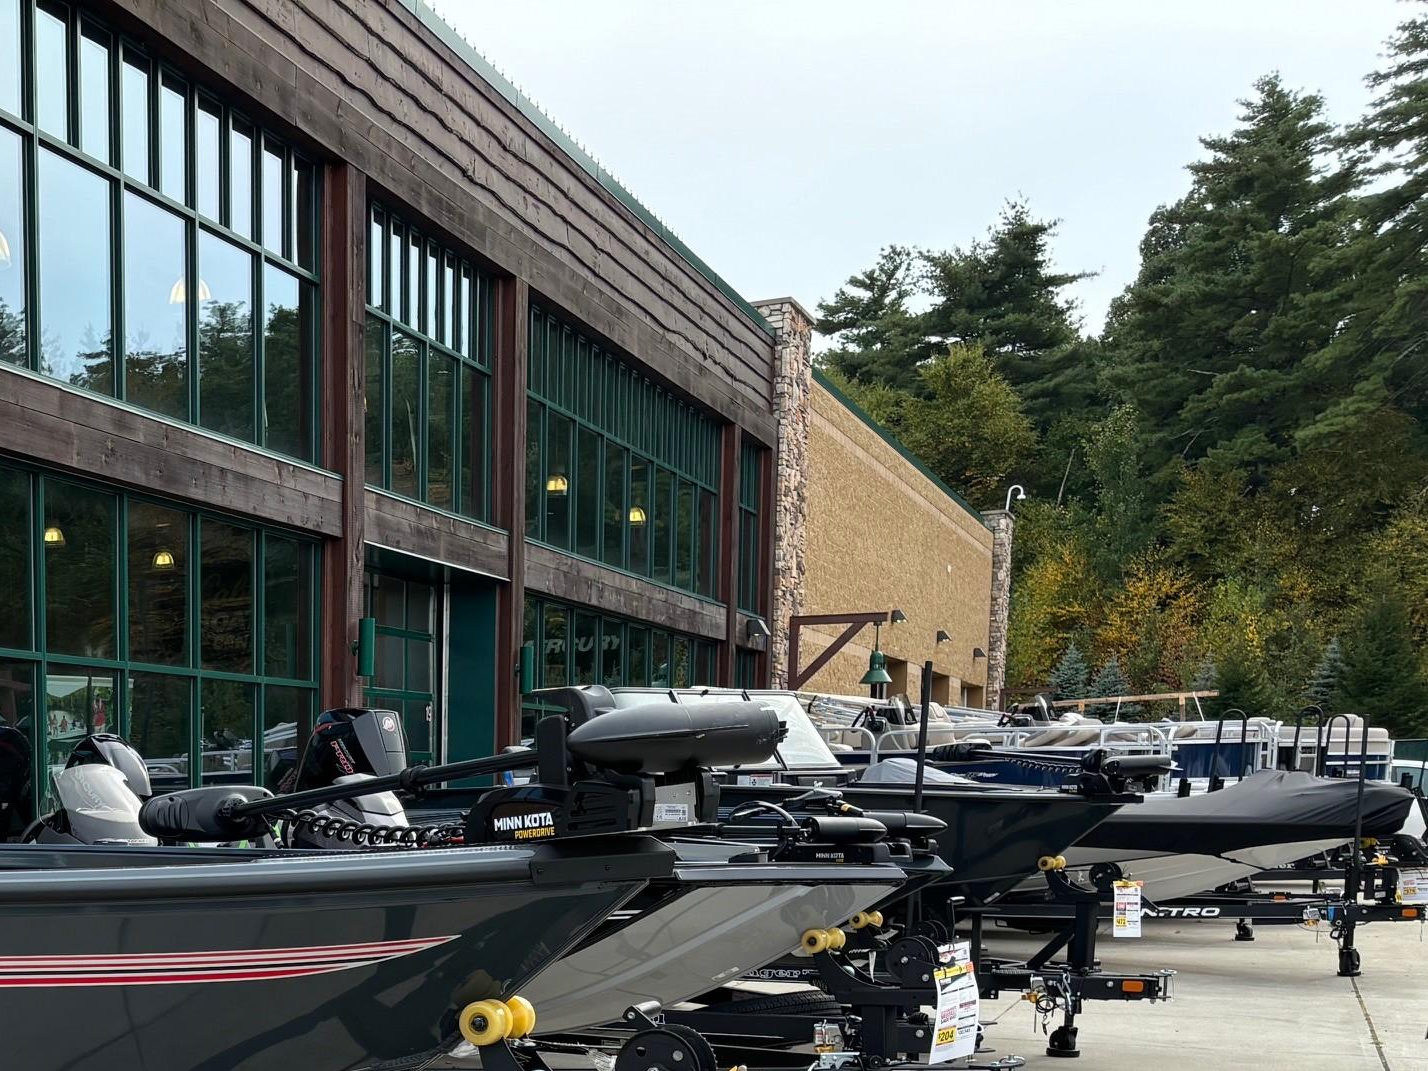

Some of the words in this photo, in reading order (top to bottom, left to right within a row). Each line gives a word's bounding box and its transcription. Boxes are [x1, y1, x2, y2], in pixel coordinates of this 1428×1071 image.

[494, 817, 523, 832] MINN
[523, 811, 554, 828] KOTA
[514, 826, 556, 841] POWERDRIVE
